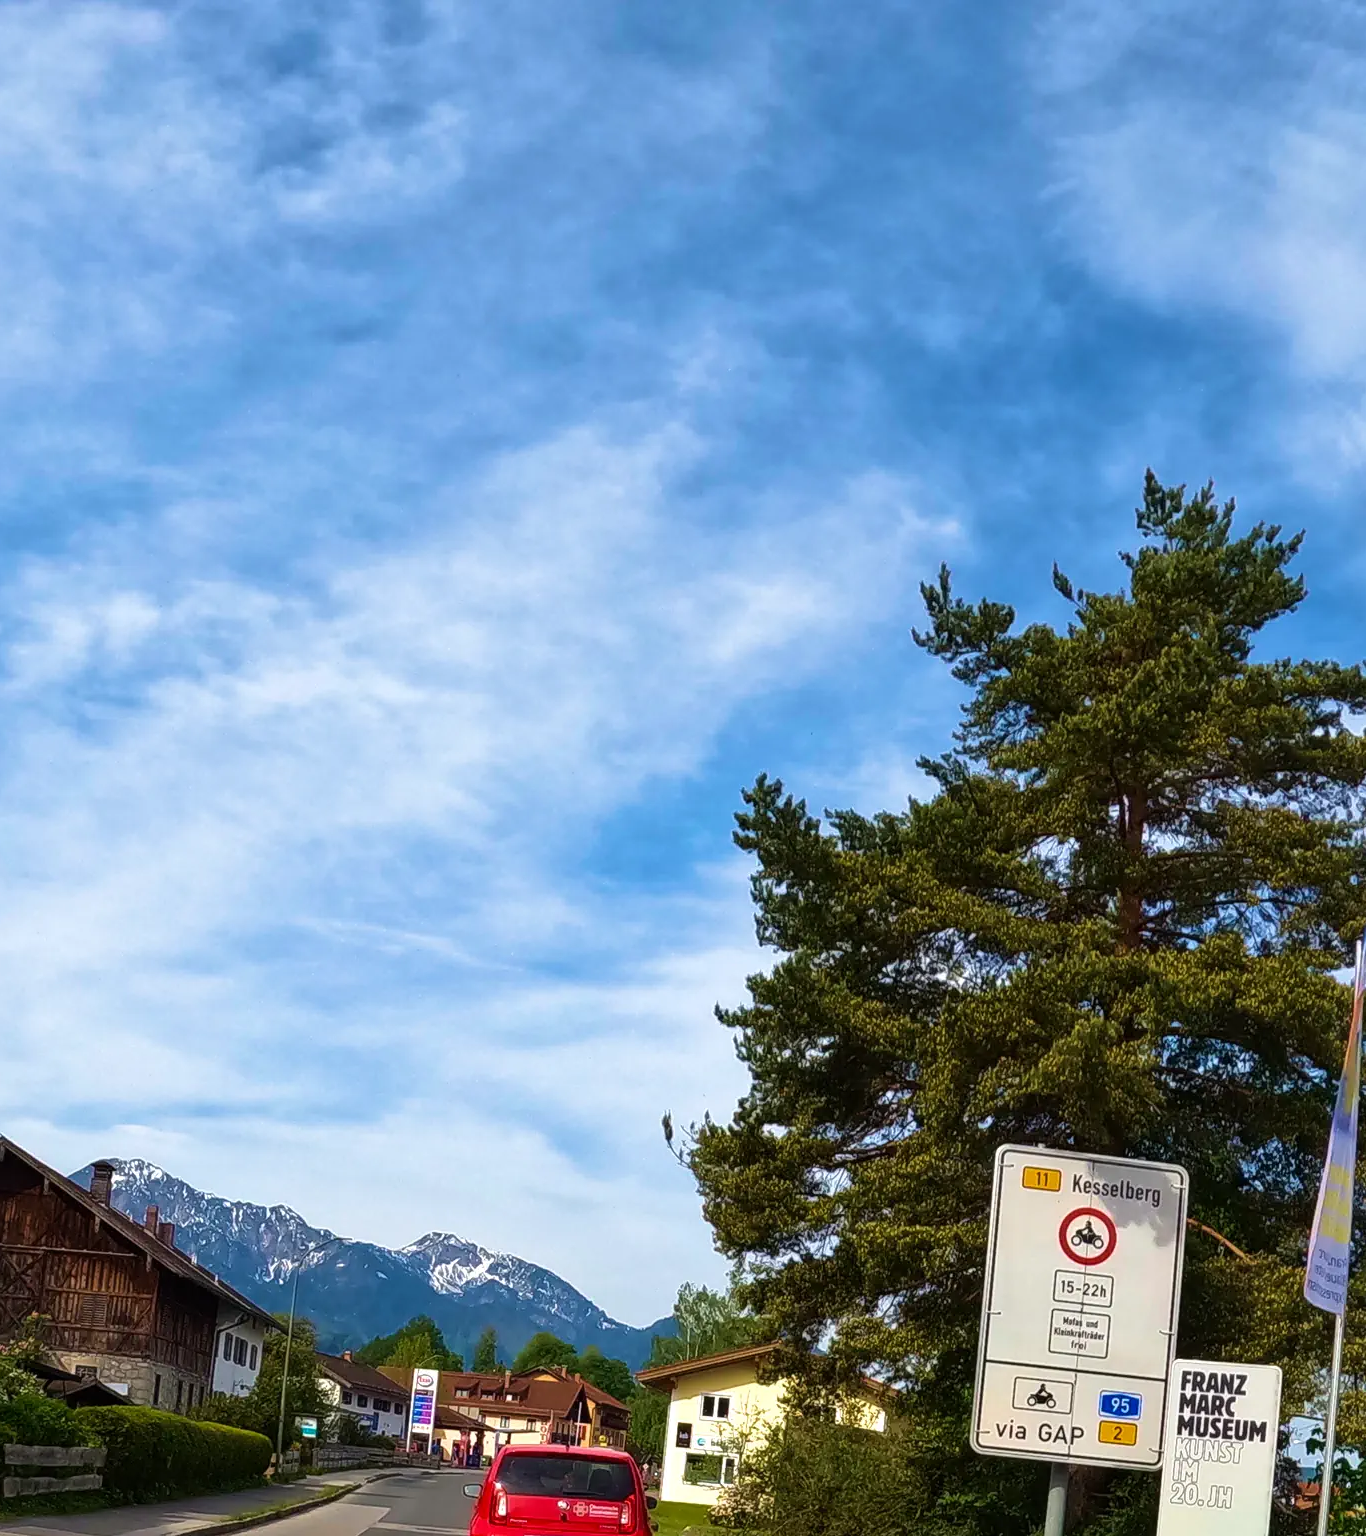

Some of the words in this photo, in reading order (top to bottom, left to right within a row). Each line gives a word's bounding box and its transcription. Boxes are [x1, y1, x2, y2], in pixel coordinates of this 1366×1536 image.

[1035, 1172, 1049, 1187] 11
[1072, 1174, 1161, 1208] Kesselberg
[1053, 1327, 1105, 1341] Kleinkrafträder
[1062, 1316, 1083, 1327] Mofas
[1085, 1320, 1099, 1329] und
[1070, 1340, 1087, 1351] frei
[1180, 1370, 1248, 1396] FRANZ
[1111, 1397, 1130, 1414] 95
[1178, 1392, 1237, 1418] MARC
[995, 1419, 1027, 1440] via
[1038, 1423, 1085, 1446] GAP
[1112, 1426, 1123, 1441] 2
[1176, 1414, 1268, 1443] MUSEUM
[1175, 1437, 1245, 1465] KUNST
[1172, 1459, 1200, 1483] IM
[1170, 1481, 1205, 1507] 20.
[1206, 1485, 1233, 1509] JH
